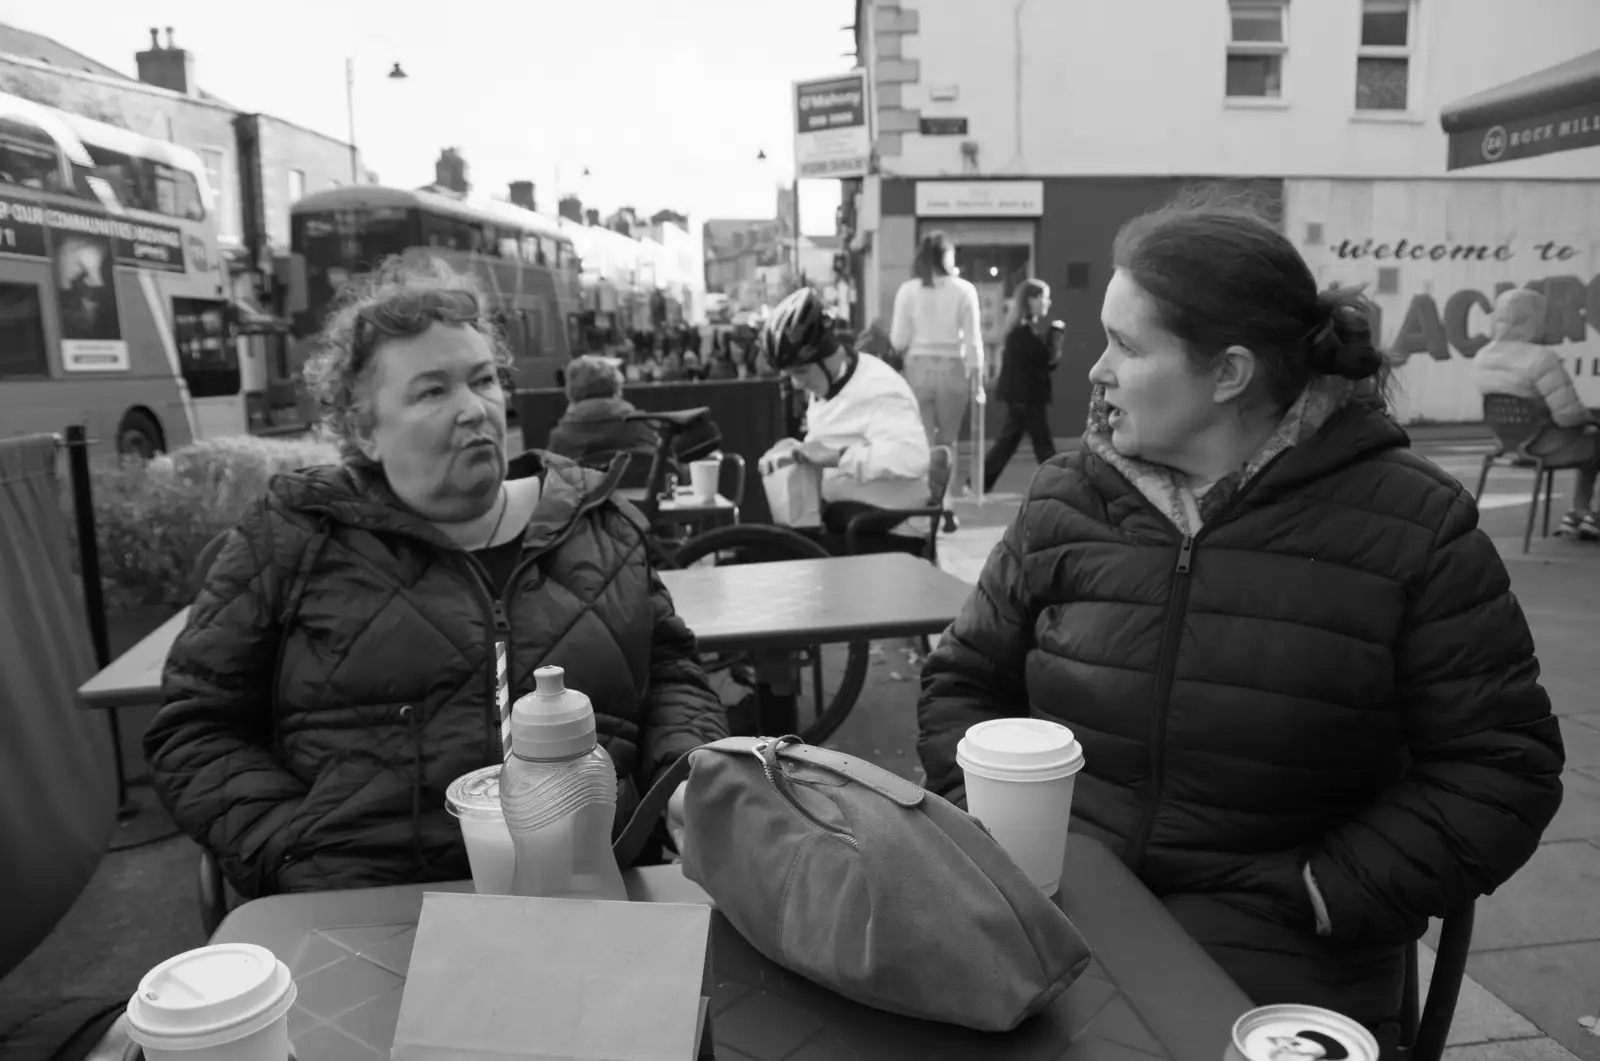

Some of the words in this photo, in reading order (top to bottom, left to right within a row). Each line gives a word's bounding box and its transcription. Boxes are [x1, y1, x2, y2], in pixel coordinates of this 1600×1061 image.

[1510, 124, 1554, 147] ROCK
[1331, 238, 1514, 261] welcome
[1533, 240, 1579, 261] to
